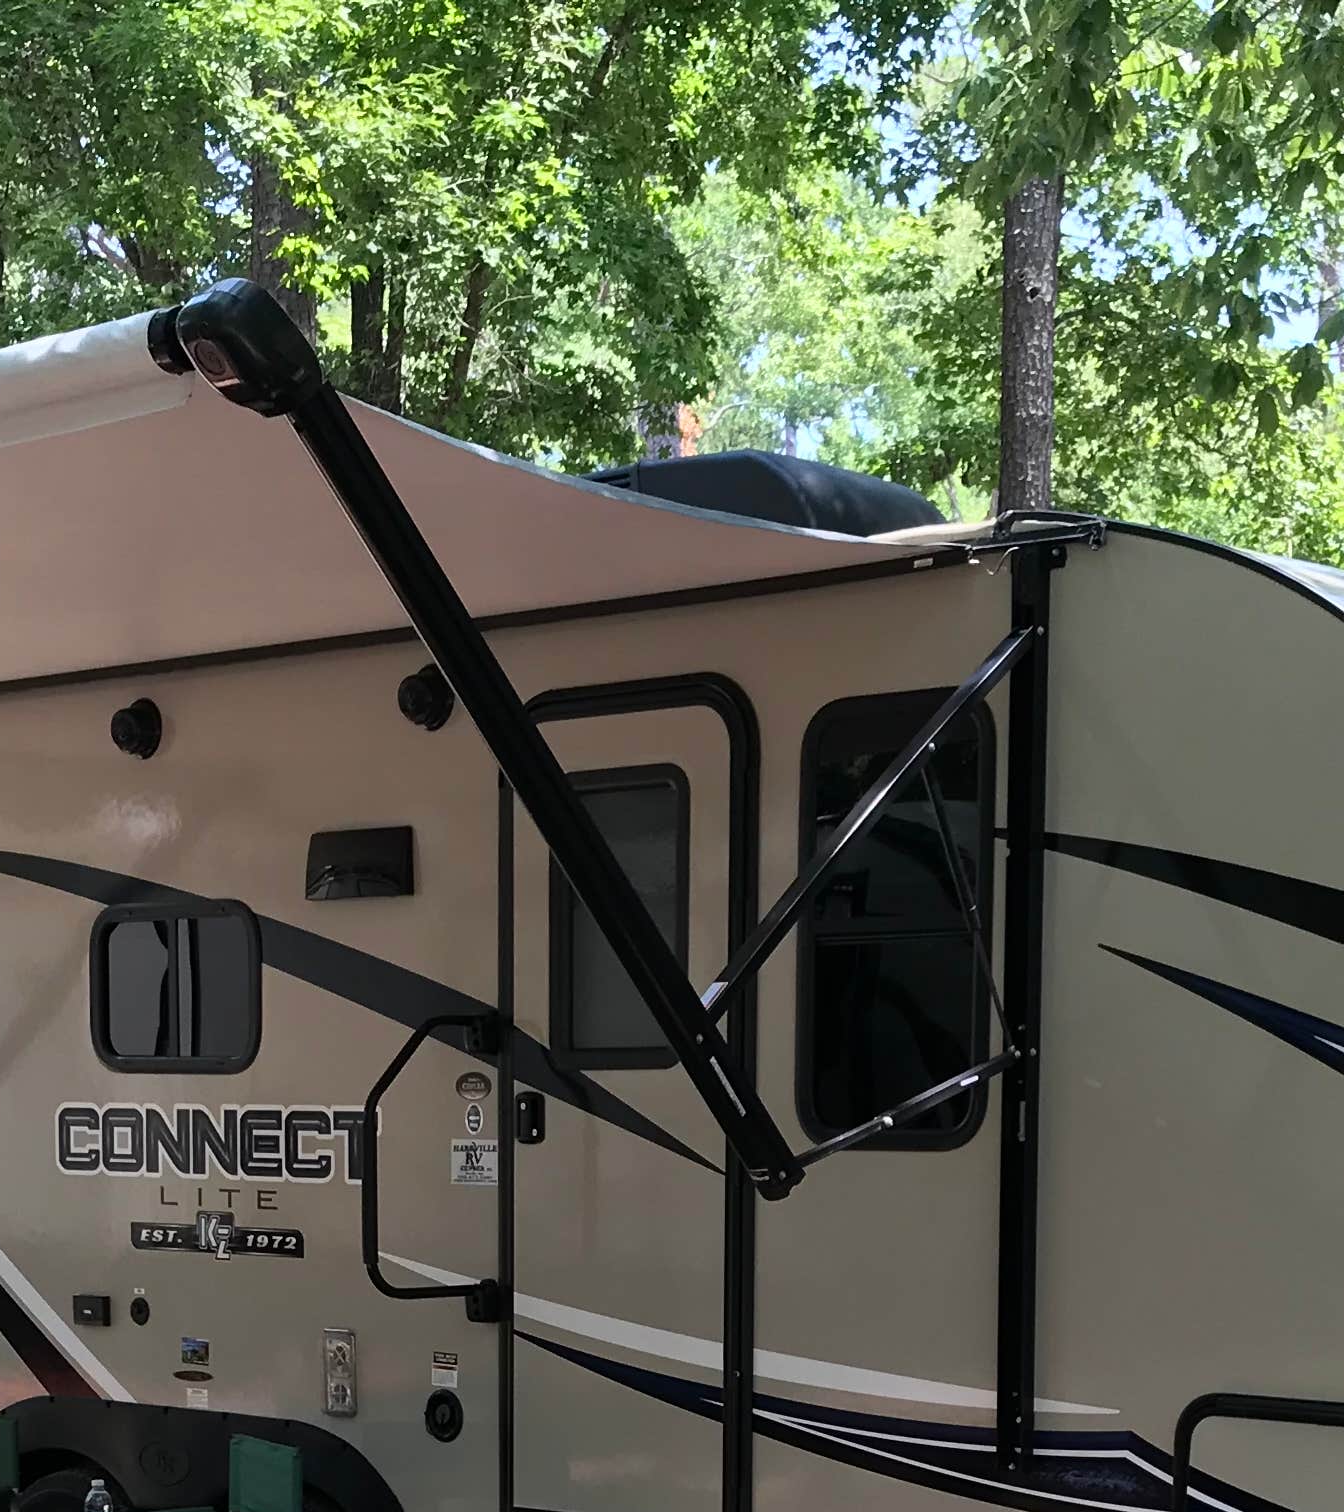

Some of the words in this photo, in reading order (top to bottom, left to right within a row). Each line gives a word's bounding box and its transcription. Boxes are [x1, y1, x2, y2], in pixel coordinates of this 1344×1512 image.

[159, 1185, 279, 1211] LITE
[140, 1228, 184, 1244] EST.
[245, 1233, 297, 1250] 1972
